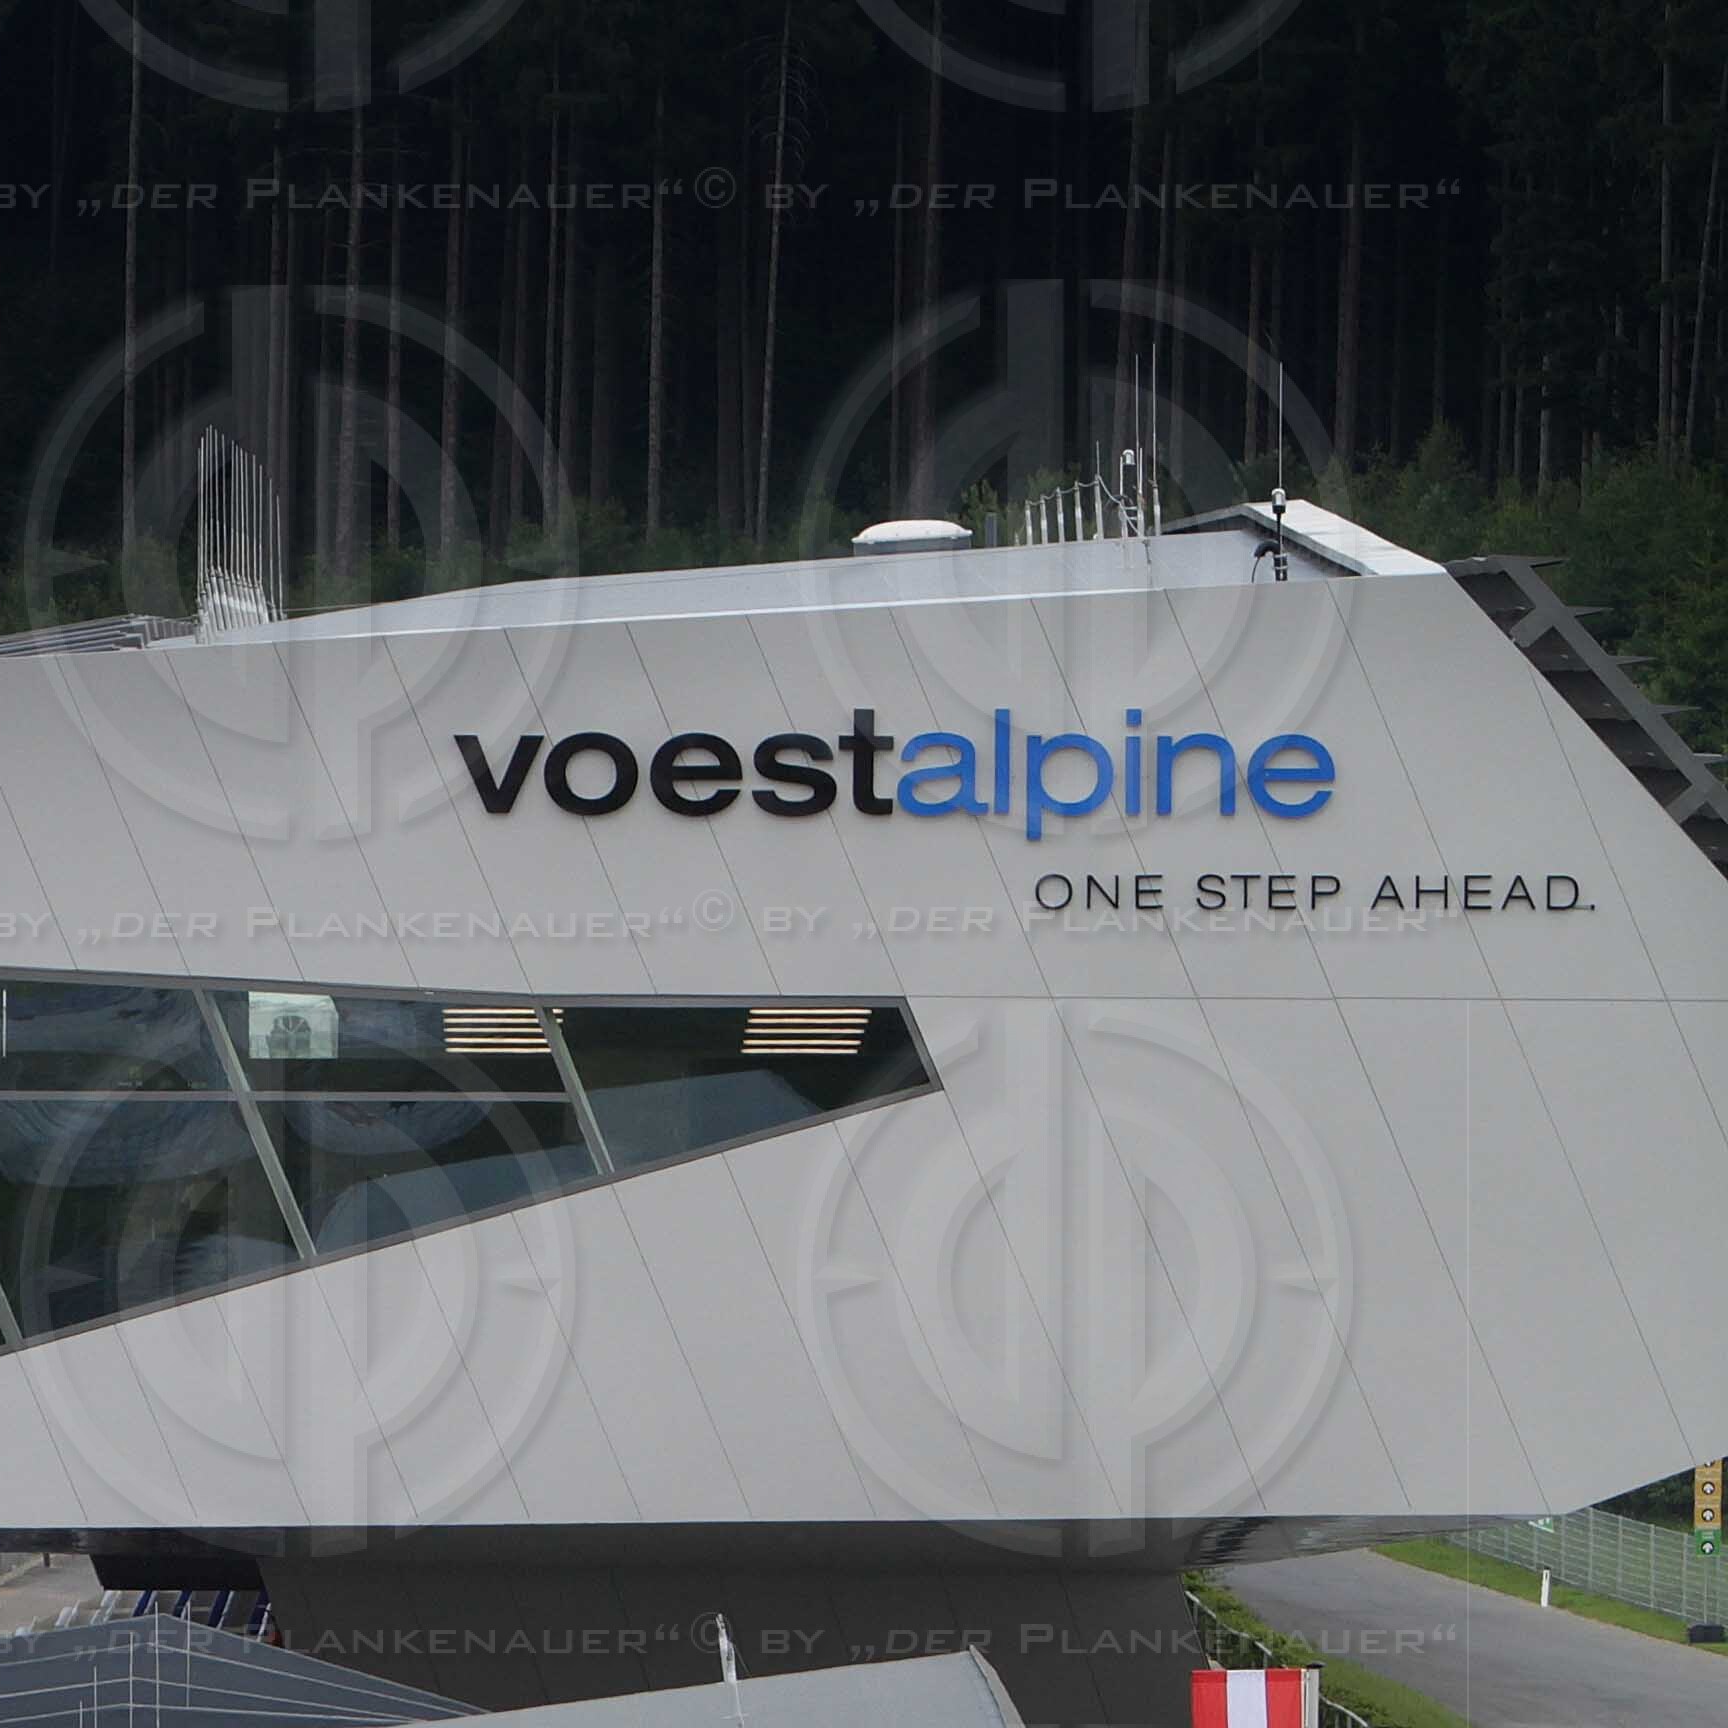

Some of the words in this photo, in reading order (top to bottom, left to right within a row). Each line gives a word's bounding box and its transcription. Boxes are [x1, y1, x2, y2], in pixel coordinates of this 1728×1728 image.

[454, 708, 1336, 841] voestalpine
[1034, 873, 1164, 912] ONE
[1195, 873, 1342, 911] STEP
[1369, 873, 1598, 912] AHEAD.
